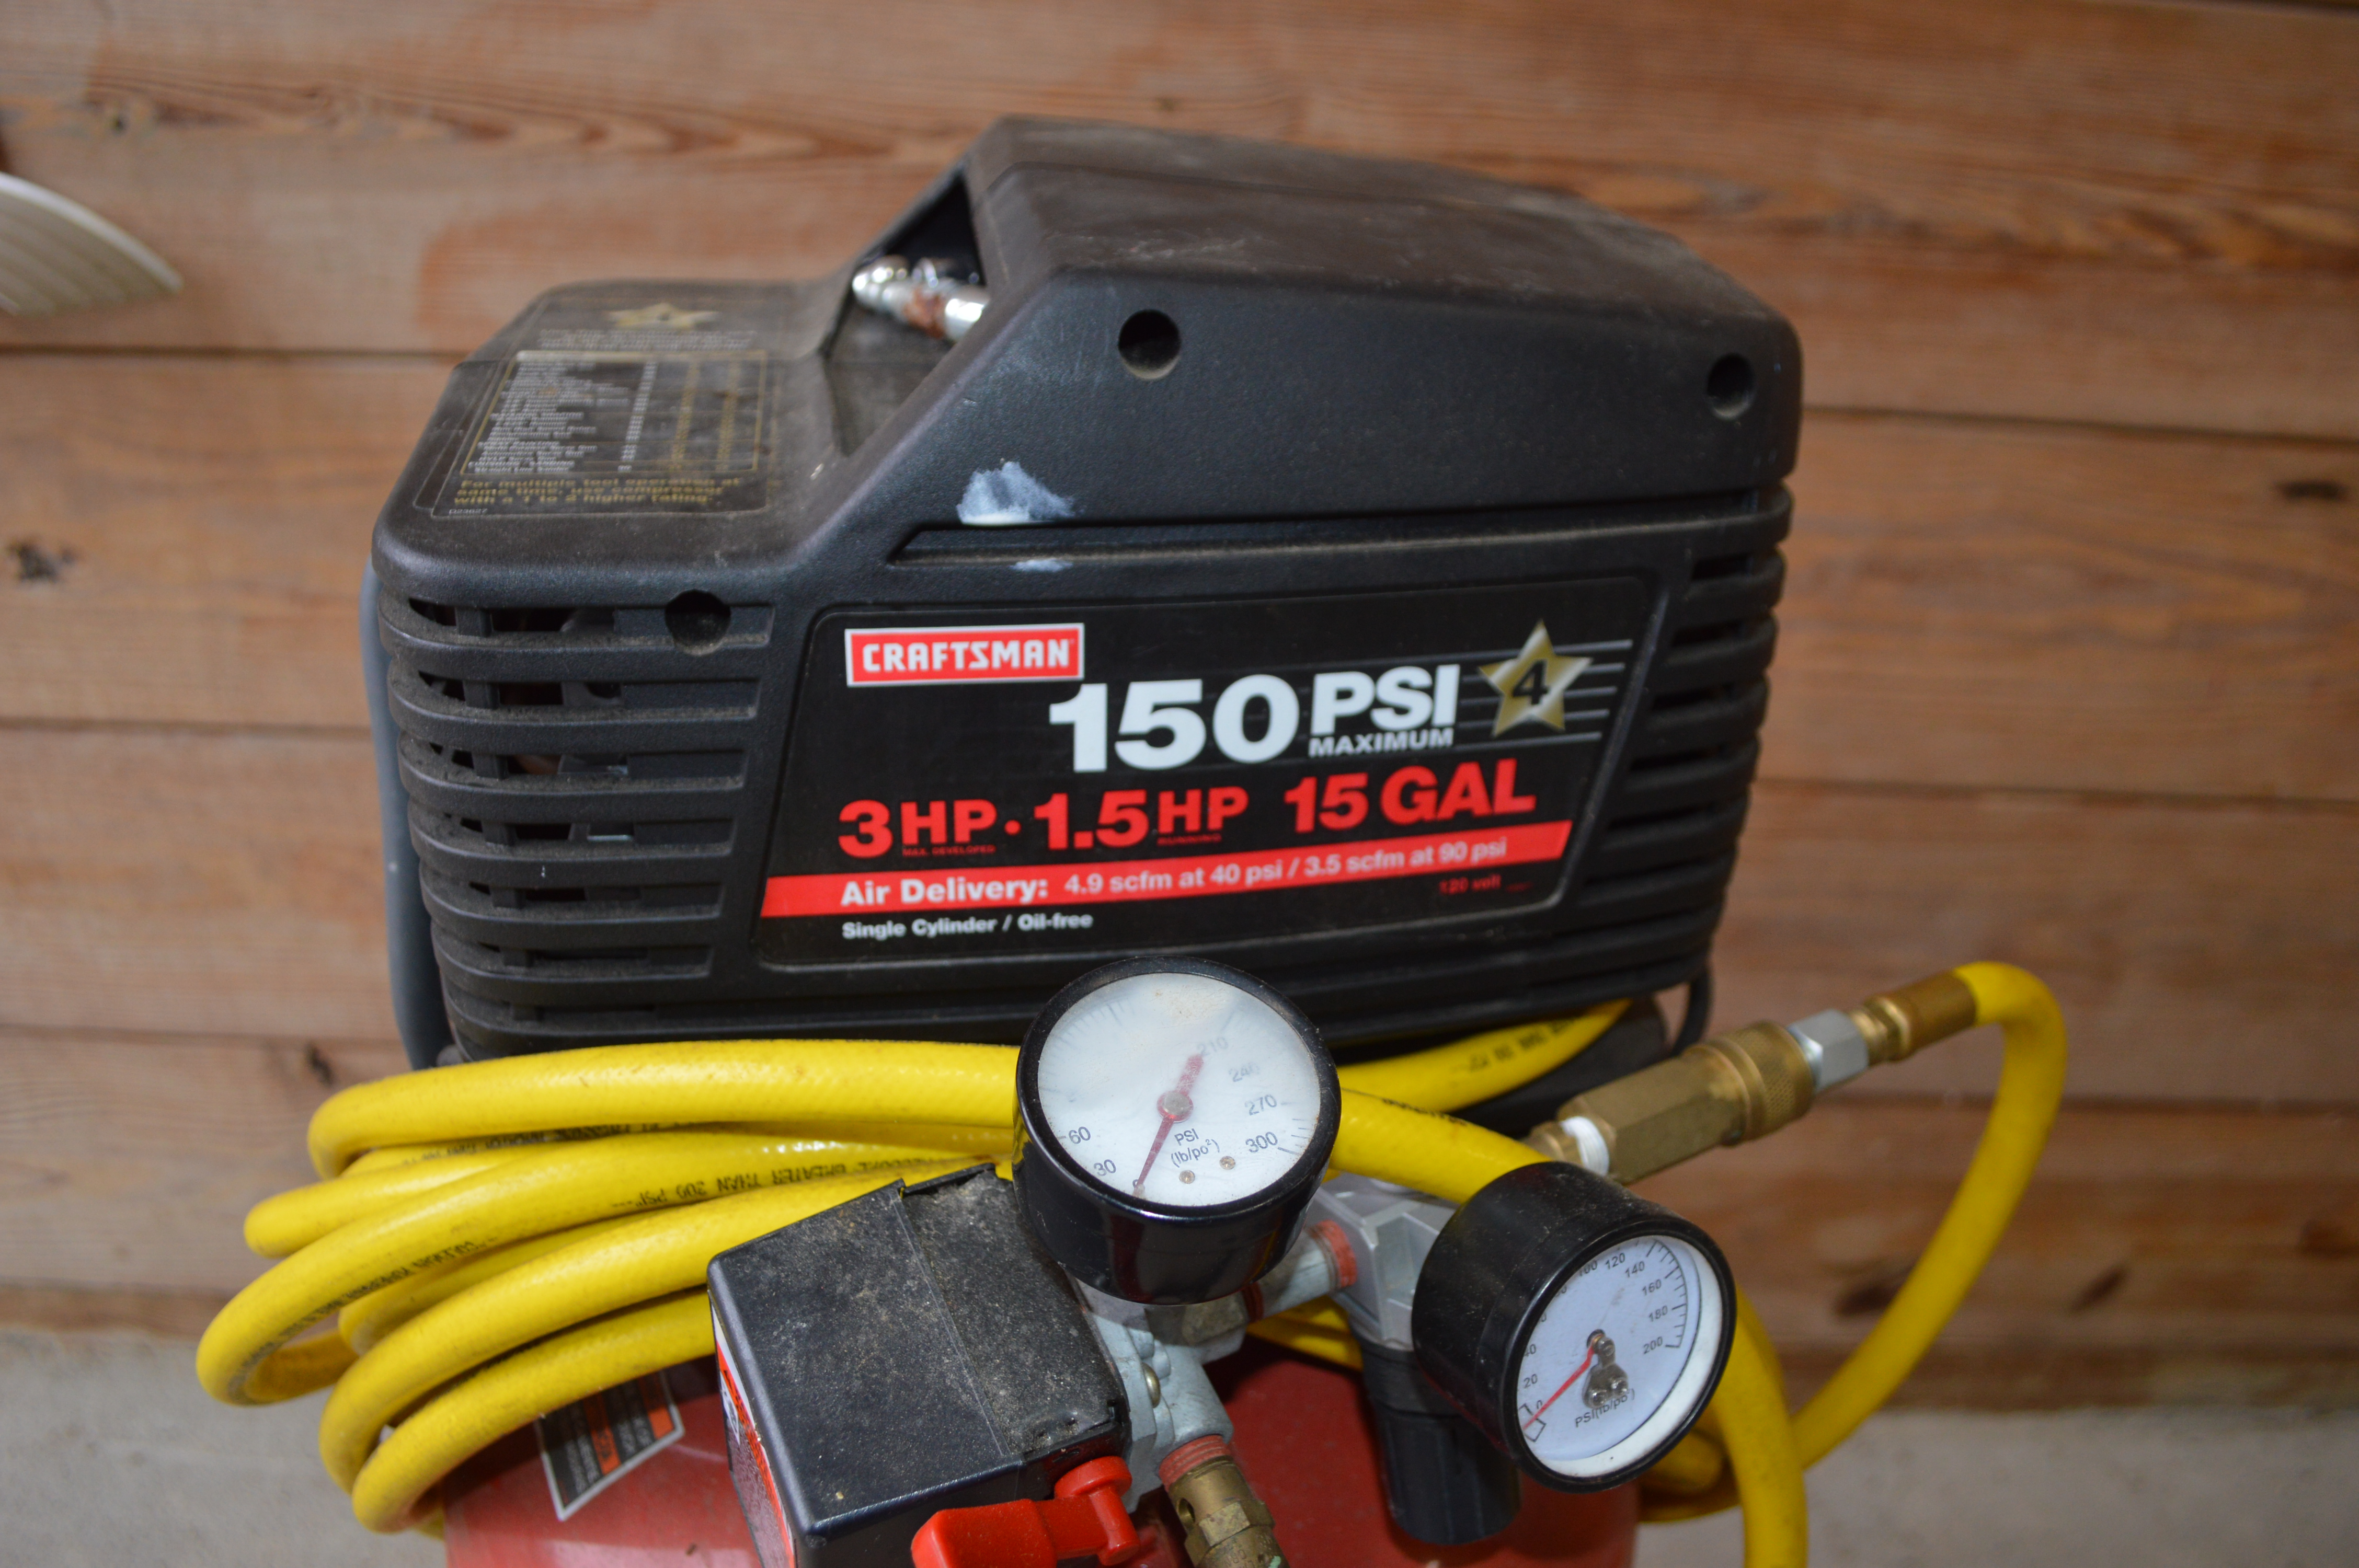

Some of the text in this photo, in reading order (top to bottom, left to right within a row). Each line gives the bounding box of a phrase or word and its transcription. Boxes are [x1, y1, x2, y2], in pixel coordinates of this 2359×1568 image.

[454, 495, 496, 505] with
[863, 639, 1069, 672] CRAFTSMAN
[1511, 659, 1549, 706] 4
[1049, 664, 1460, 773] 150 PSI
[1308, 728, 1453, 758] MAXIMUM
[1284, 772, 1369, 833] 15
[1380, 758, 1537, 826] GAL
[931, 844, 997, 856] DEVELOPED
[841, 881, 890, 907] Air
[900, 876, 1049, 905] Delivery:
[1064, 873, 1104, 895] 4.9
[1109, 869, 1173, 893] scfm
[1178, 867, 1205, 888] at
[1209, 863, 1241, 885] 40
[1245, 858, 1284, 887] psi
[1303, 853, 1342, 878] 3.5
[1345, 849, 1405, 874] scfm
[1410, 845, 1434, 868] at
[1438, 840, 1469, 864] 90
[1470, 836, 1507, 866] psi
[842, 921, 907, 941] Single
[911, 917, 998, 938] Cylinder
[1017, 912, 1094, 931] Oil-free
[1244, 1094, 1277, 1116] 270
[1068, 1126, 1091, 1144] 60
[1174, 1128, 1199, 1146] PSI
[1245, 1131, 1278, 1153] 300
[1093, 1159, 1117, 1177] 30
[676, 1180, 706, 1199] 300
[717, 1172, 761, 1192] THAN
[1605, 1252, 1626, 1270] 120
[1625, 1261, 1645, 1278] 140
[1642, 1278, 1662, 1296] 160
[1648, 1305, 1668, 1322] 180
[1643, 1336, 1664, 1354] 200
[1524, 1373, 1538, 1389] 20
